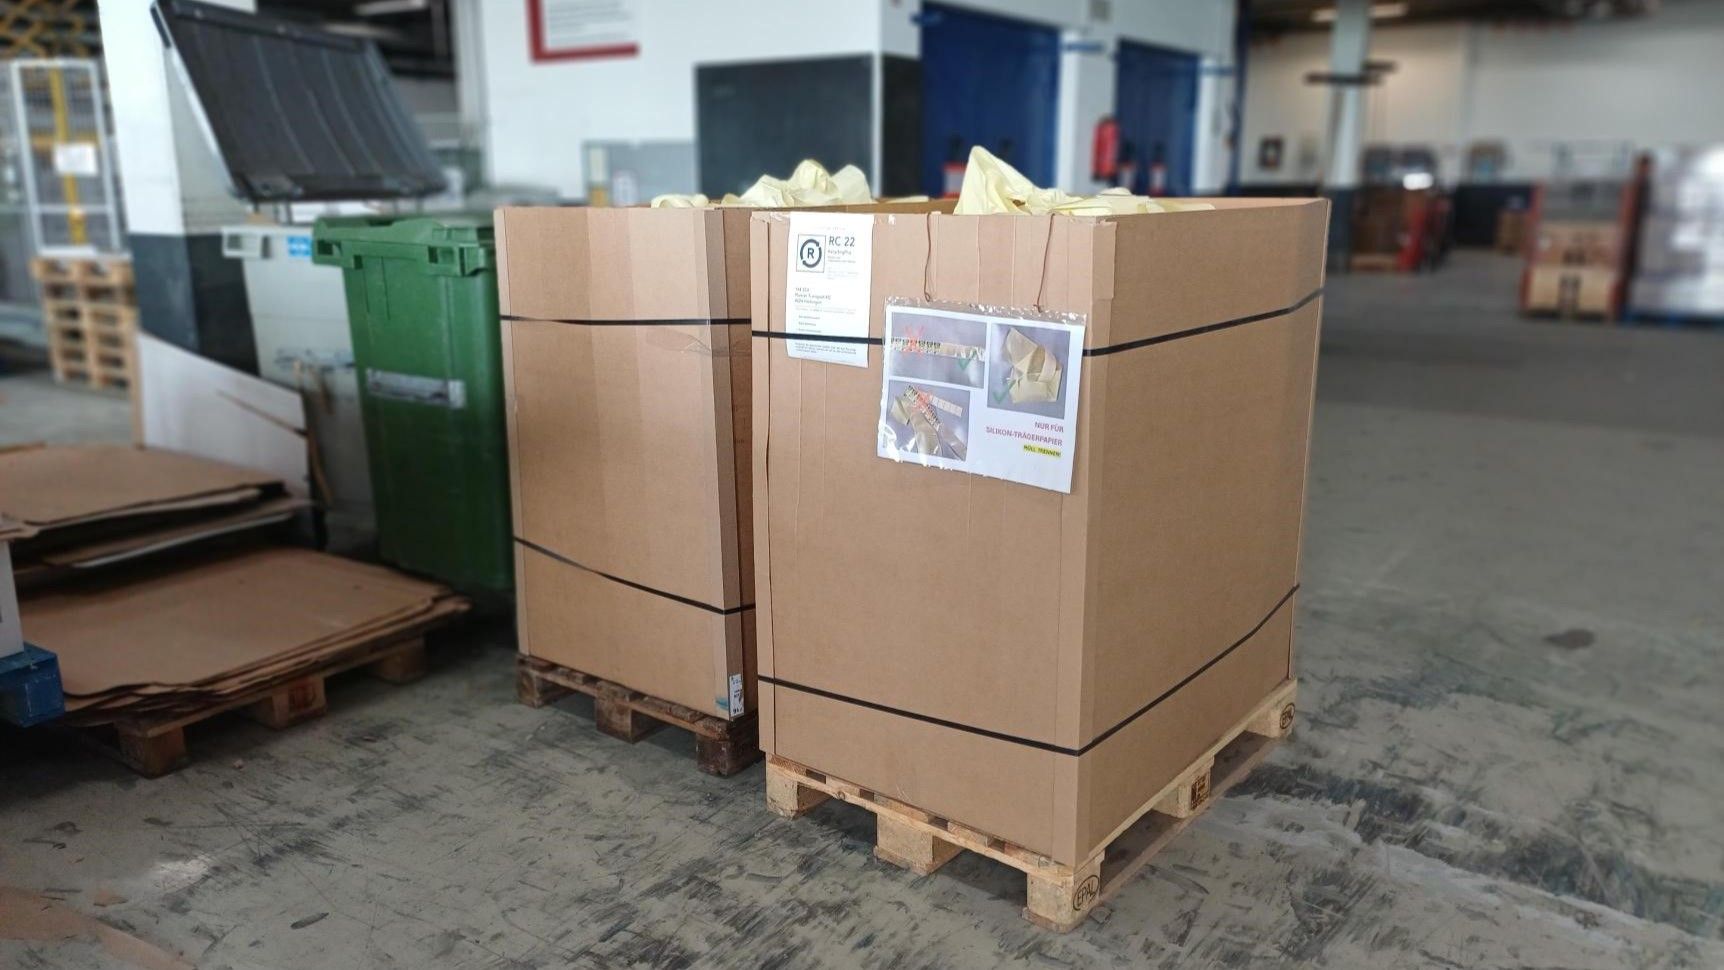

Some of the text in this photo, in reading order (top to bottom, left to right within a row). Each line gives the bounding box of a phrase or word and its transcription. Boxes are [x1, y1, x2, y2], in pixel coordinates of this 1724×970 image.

[828, 235, 855, 247] RC 22
[807, 247, 815, 259] R
[1034, 421, 1064, 433] NUR FÜR
[985, 426, 1063, 446] SILIKON-TRÄGERPAPIER
[1077, 880, 1097, 907] EPAL
